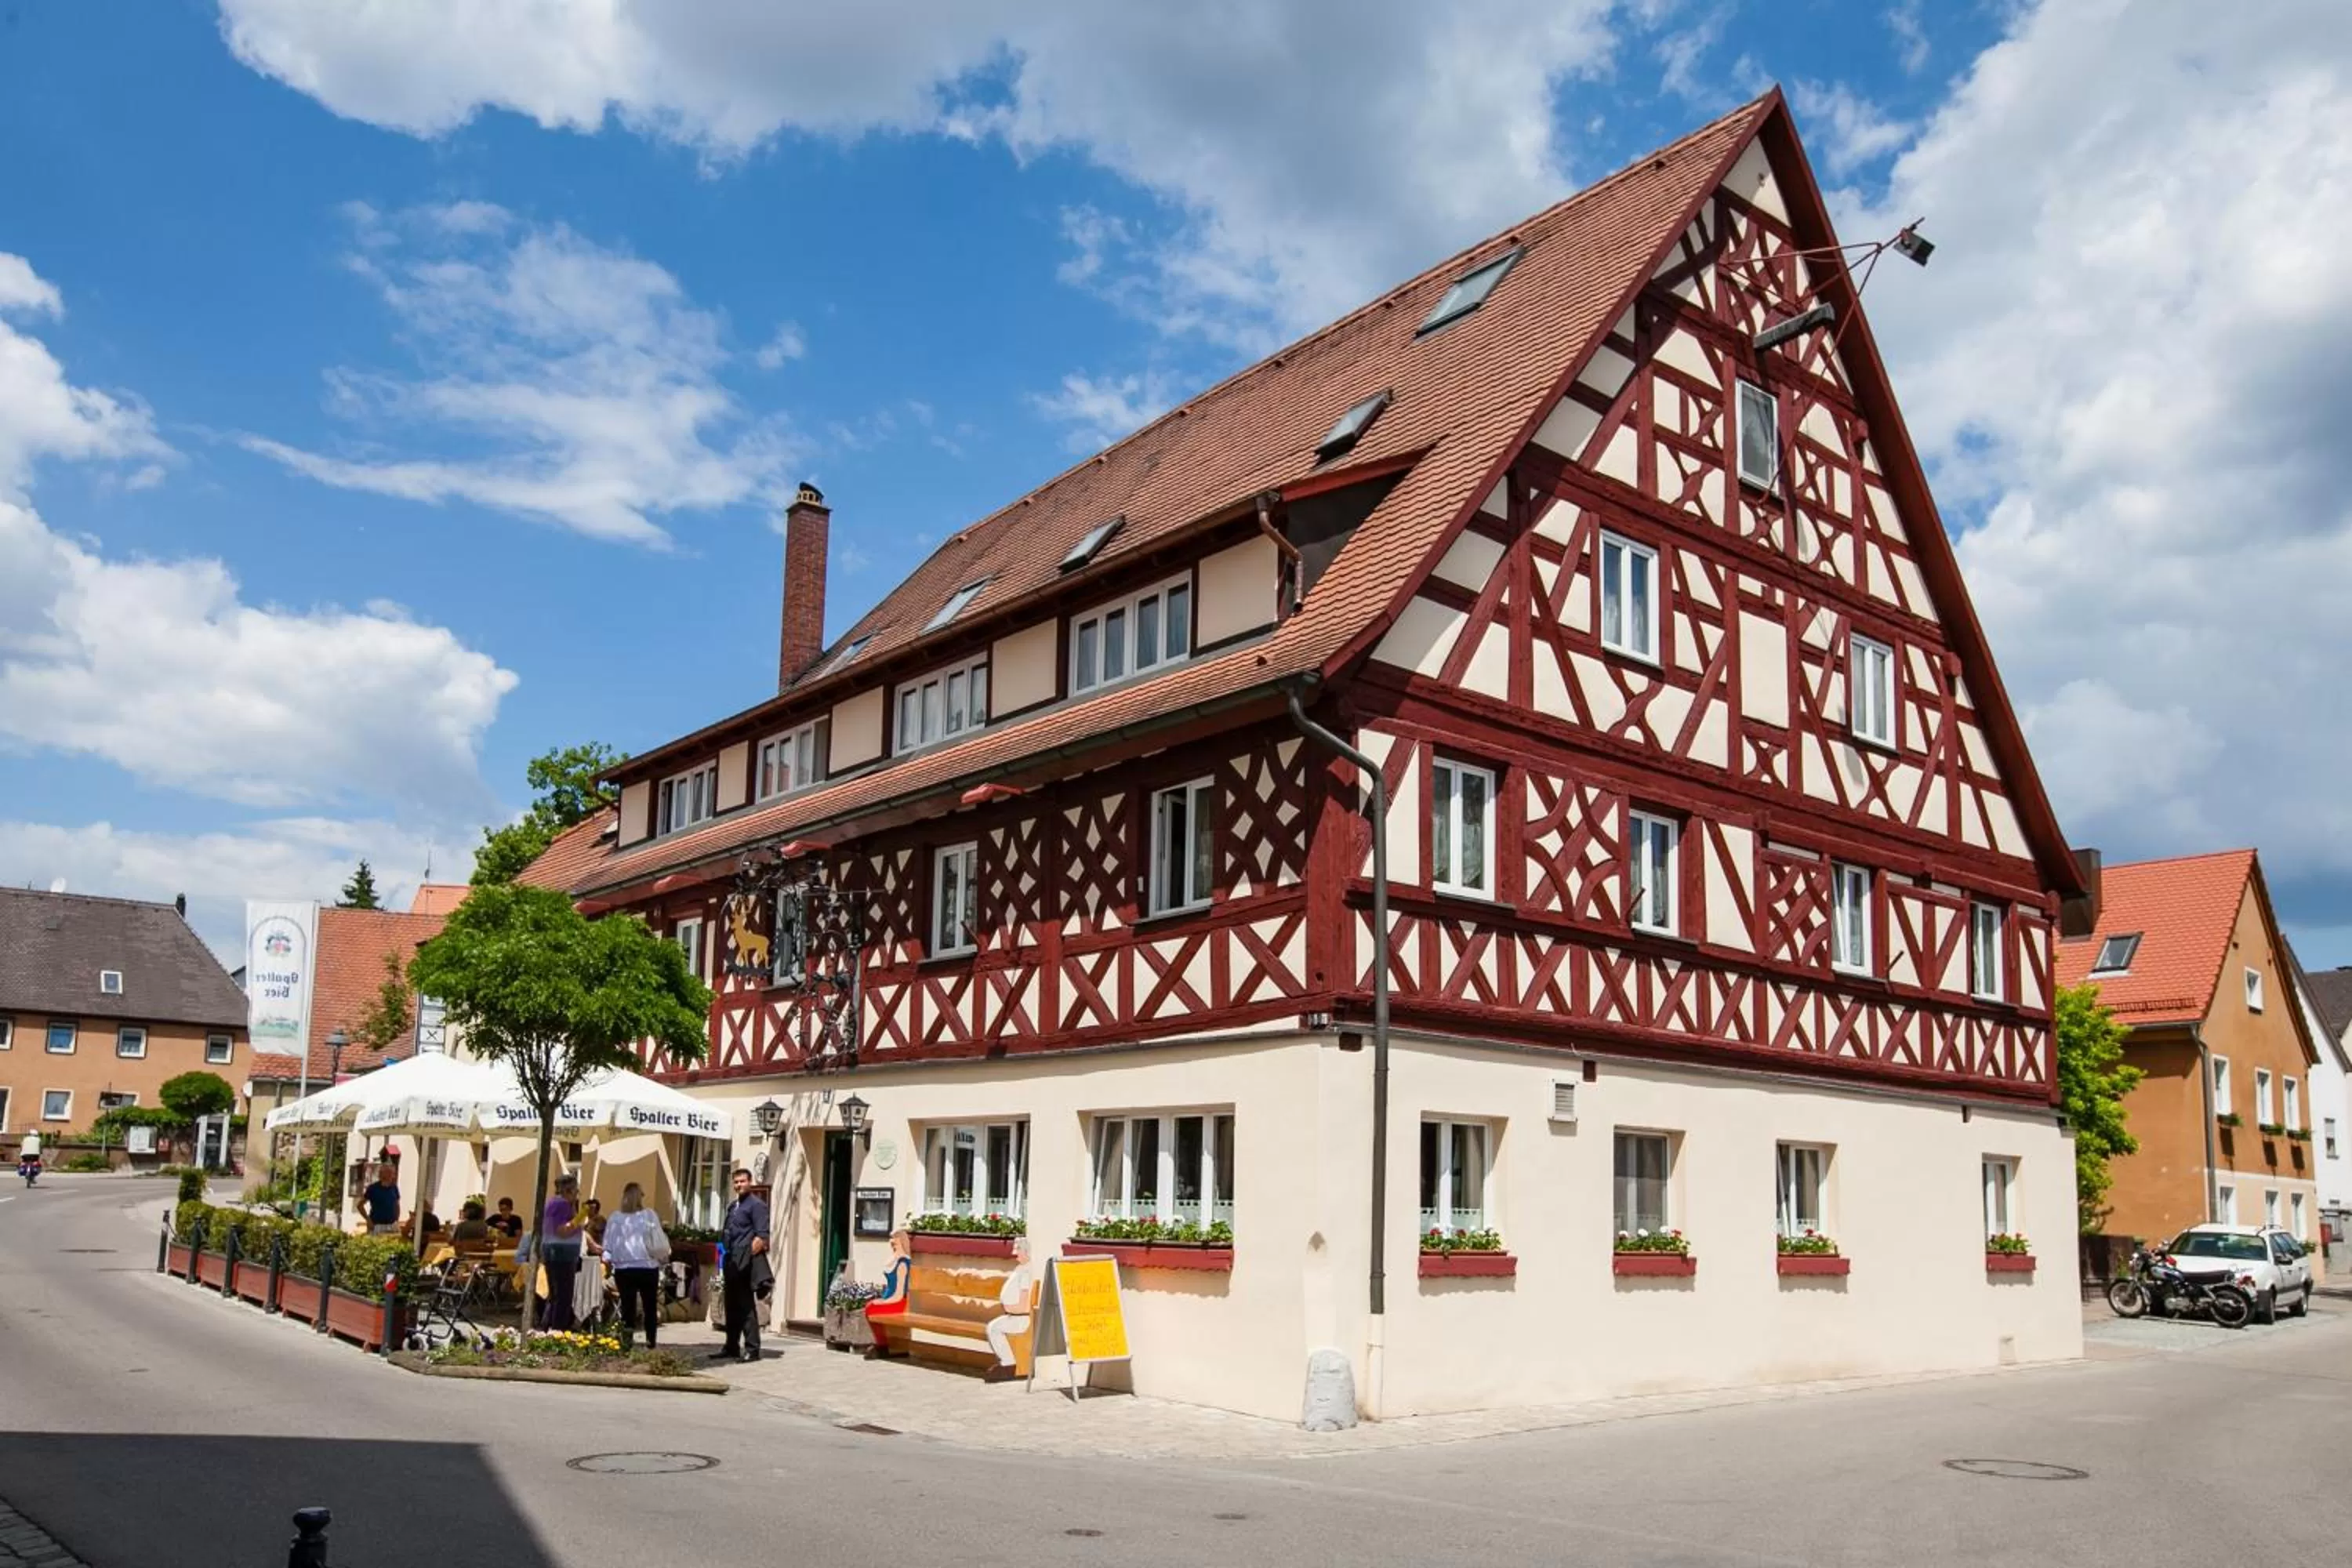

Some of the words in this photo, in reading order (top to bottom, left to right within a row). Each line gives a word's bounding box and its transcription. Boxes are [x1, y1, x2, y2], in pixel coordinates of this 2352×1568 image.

[495, 1105, 551, 1122] Spalt
[560, 1104, 595, 1120] Bier
[630, 1106, 681, 1126] Spalter
[688, 1113, 719, 1132] Bier
